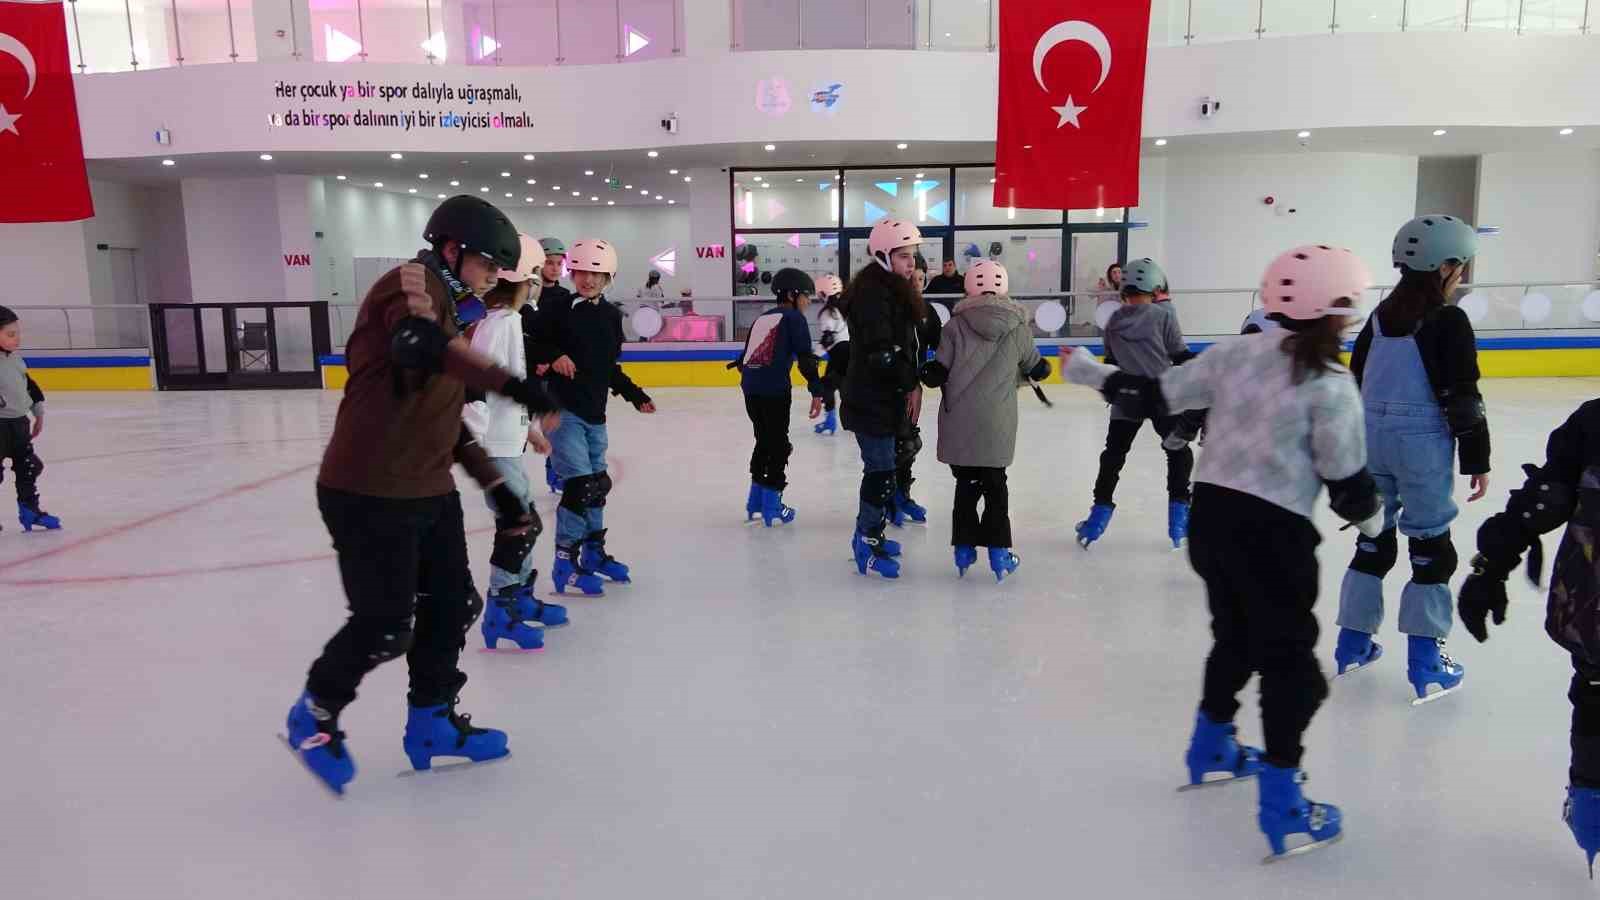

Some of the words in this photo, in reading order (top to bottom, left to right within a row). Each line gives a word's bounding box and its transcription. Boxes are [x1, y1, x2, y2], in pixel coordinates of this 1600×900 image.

[275, 80, 296, 97] Her
[300, 80, 337, 101] çocuk
[339, 84, 355, 101] ya
[357, 80, 375, 97] bir
[379, 84, 407, 102] spor
[412, 81, 454, 104] dalıyla
[458, 83, 522, 104] uğraşmalı,
[284, 109, 299, 126] da
[302, 109, 320, 126] bir
[322, 112, 352, 130] spor
[353, 109, 398, 126] dalının
[399, 110, 416, 131] iyi
[418, 111, 436, 127] bir
[439, 111, 491, 131] izleyicisi
[492, 111, 534, 128] olmalı.
[283, 254, 311, 266] VAN
[695, 246, 725, 258] VAN
